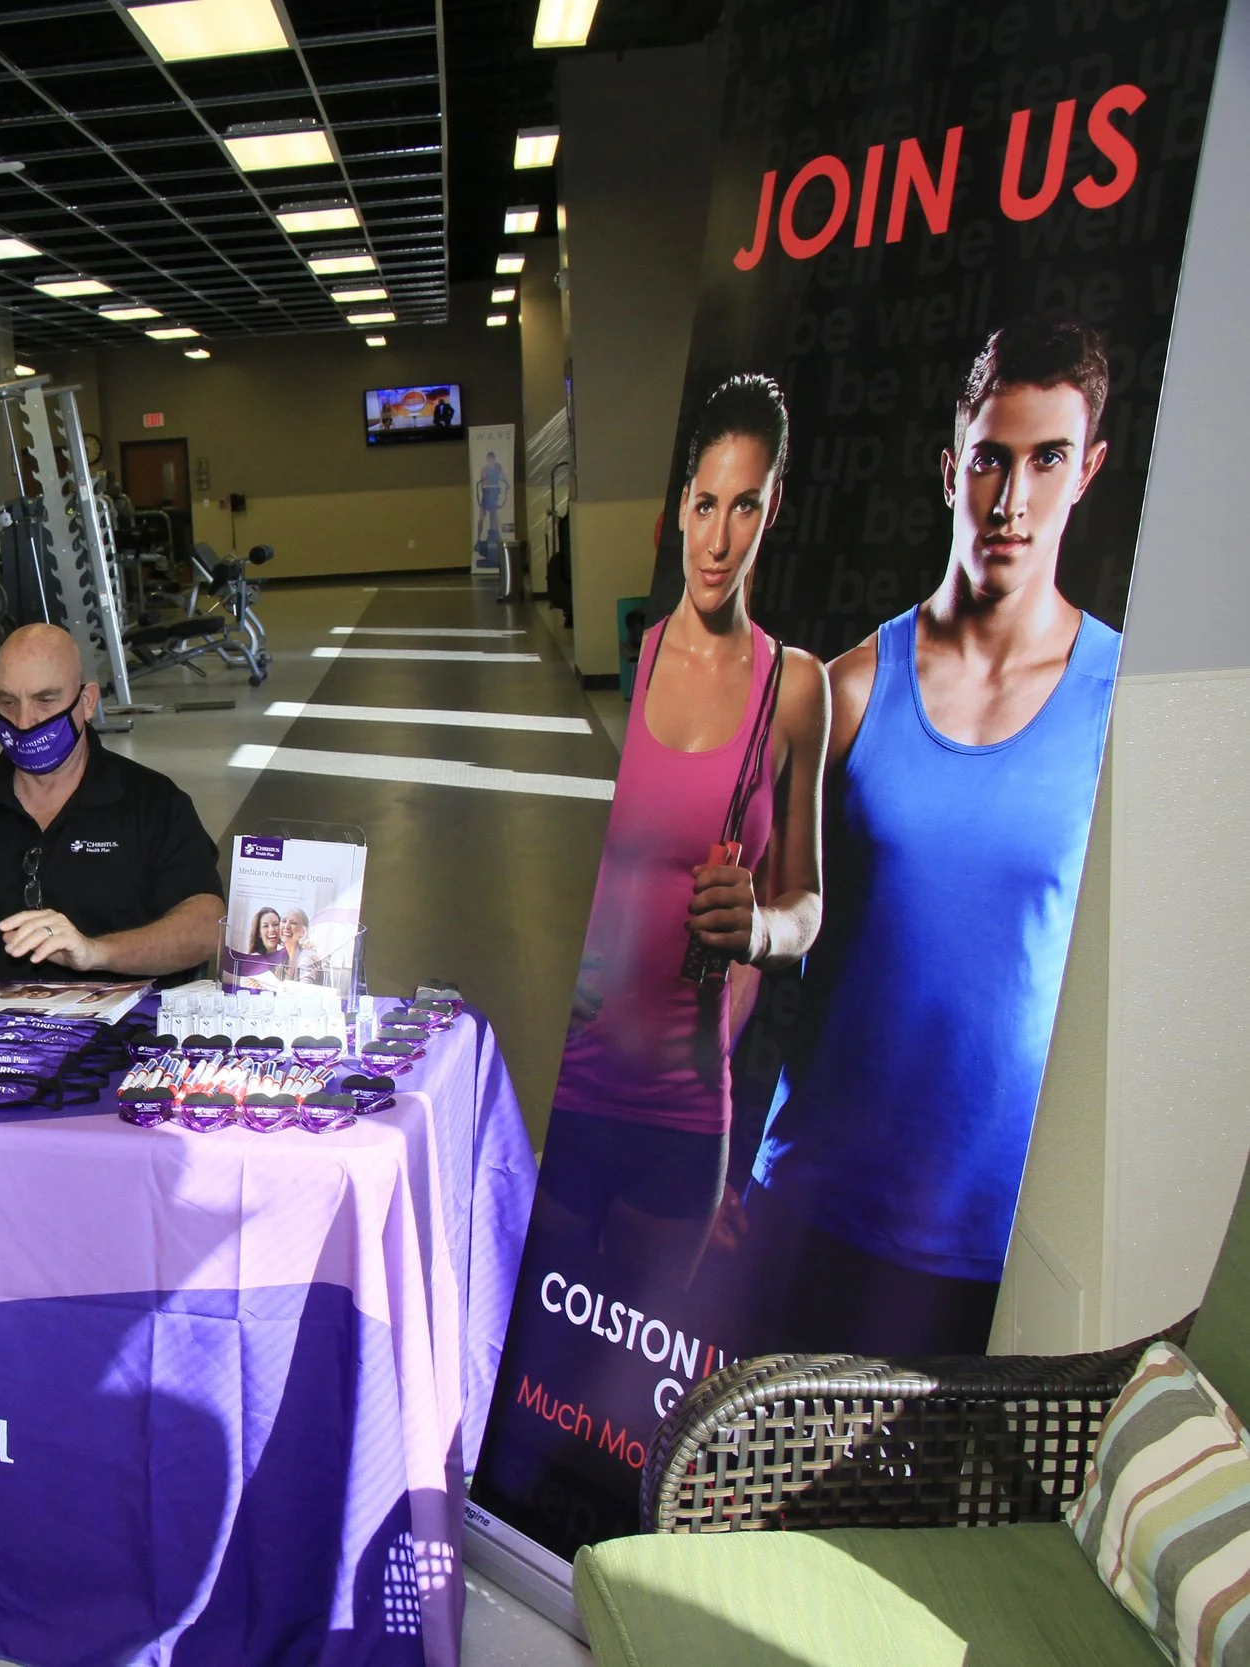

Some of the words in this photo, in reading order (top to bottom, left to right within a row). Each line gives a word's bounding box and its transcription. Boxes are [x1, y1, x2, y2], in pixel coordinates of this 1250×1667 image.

[733, 125, 963, 271] JOIN
[999, 83, 1147, 222] US
[238, 866, 269, 877] Medicare
[269, 870, 306, 881] Advantage
[306, 873, 334, 884] Options
[13, 1055, 29, 1064] Plan
[598, 1419, 646, 1470] Mo
